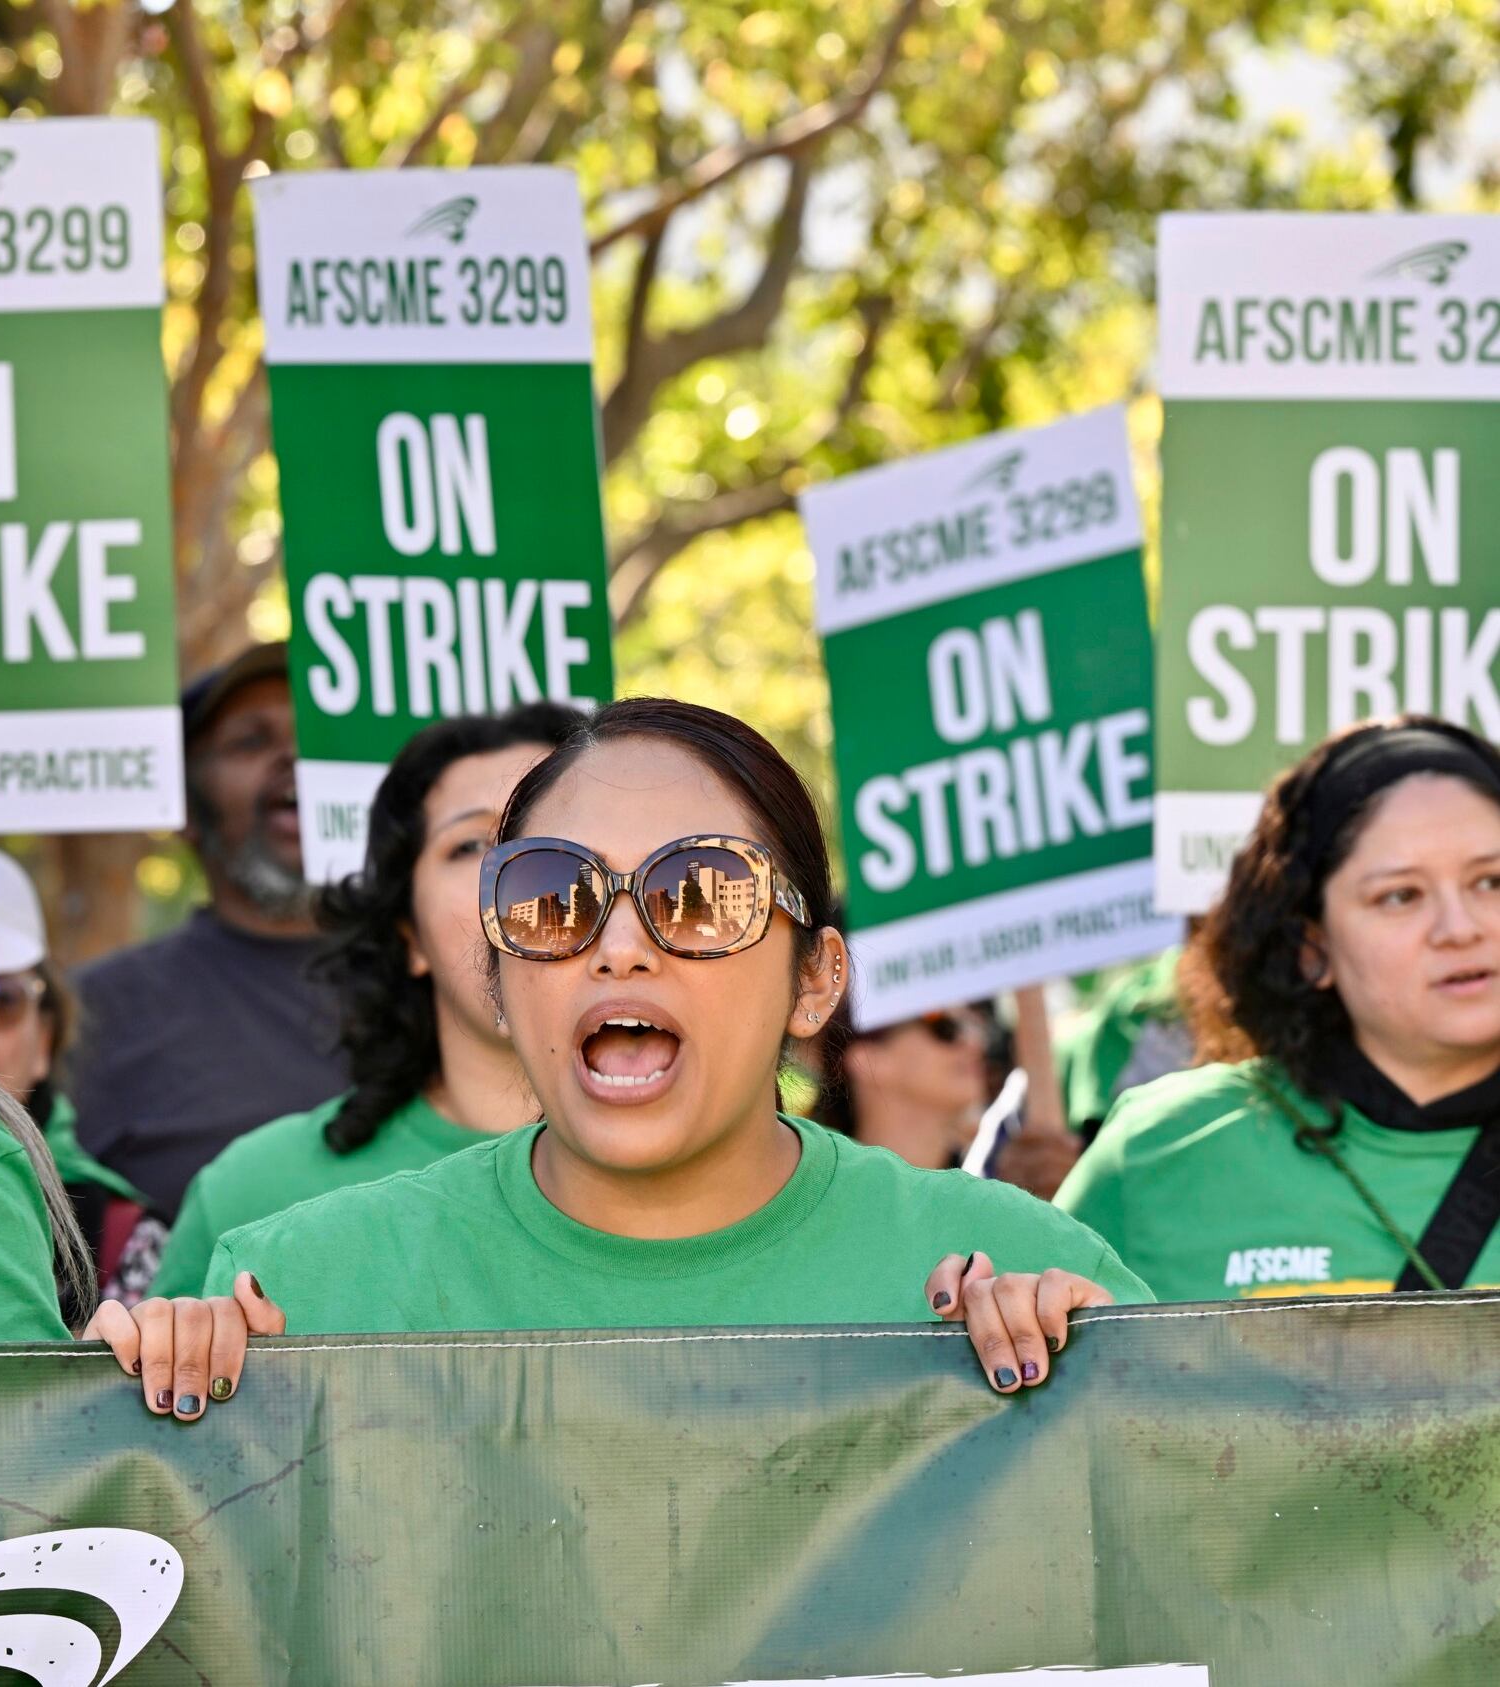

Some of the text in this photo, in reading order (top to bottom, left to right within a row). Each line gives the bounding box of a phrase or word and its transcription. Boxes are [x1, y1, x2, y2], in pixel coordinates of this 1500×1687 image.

[285, 254, 568, 329] AFSCME 3299
[1193, 295, 1500, 365] AFSCME 32
[376, 410, 498, 556] ON
[834, 469, 1119, 598] AFSCME 3299
[1309, 445, 1461, 588] ON
[303, 571, 598, 718] STRIKE
[927, 607, 1053, 745] ON
[1186, 604, 1500, 746] STRIK
[854, 708, 1155, 893] STRIKE
[1224, 1246, 1333, 1287] AFSCME
